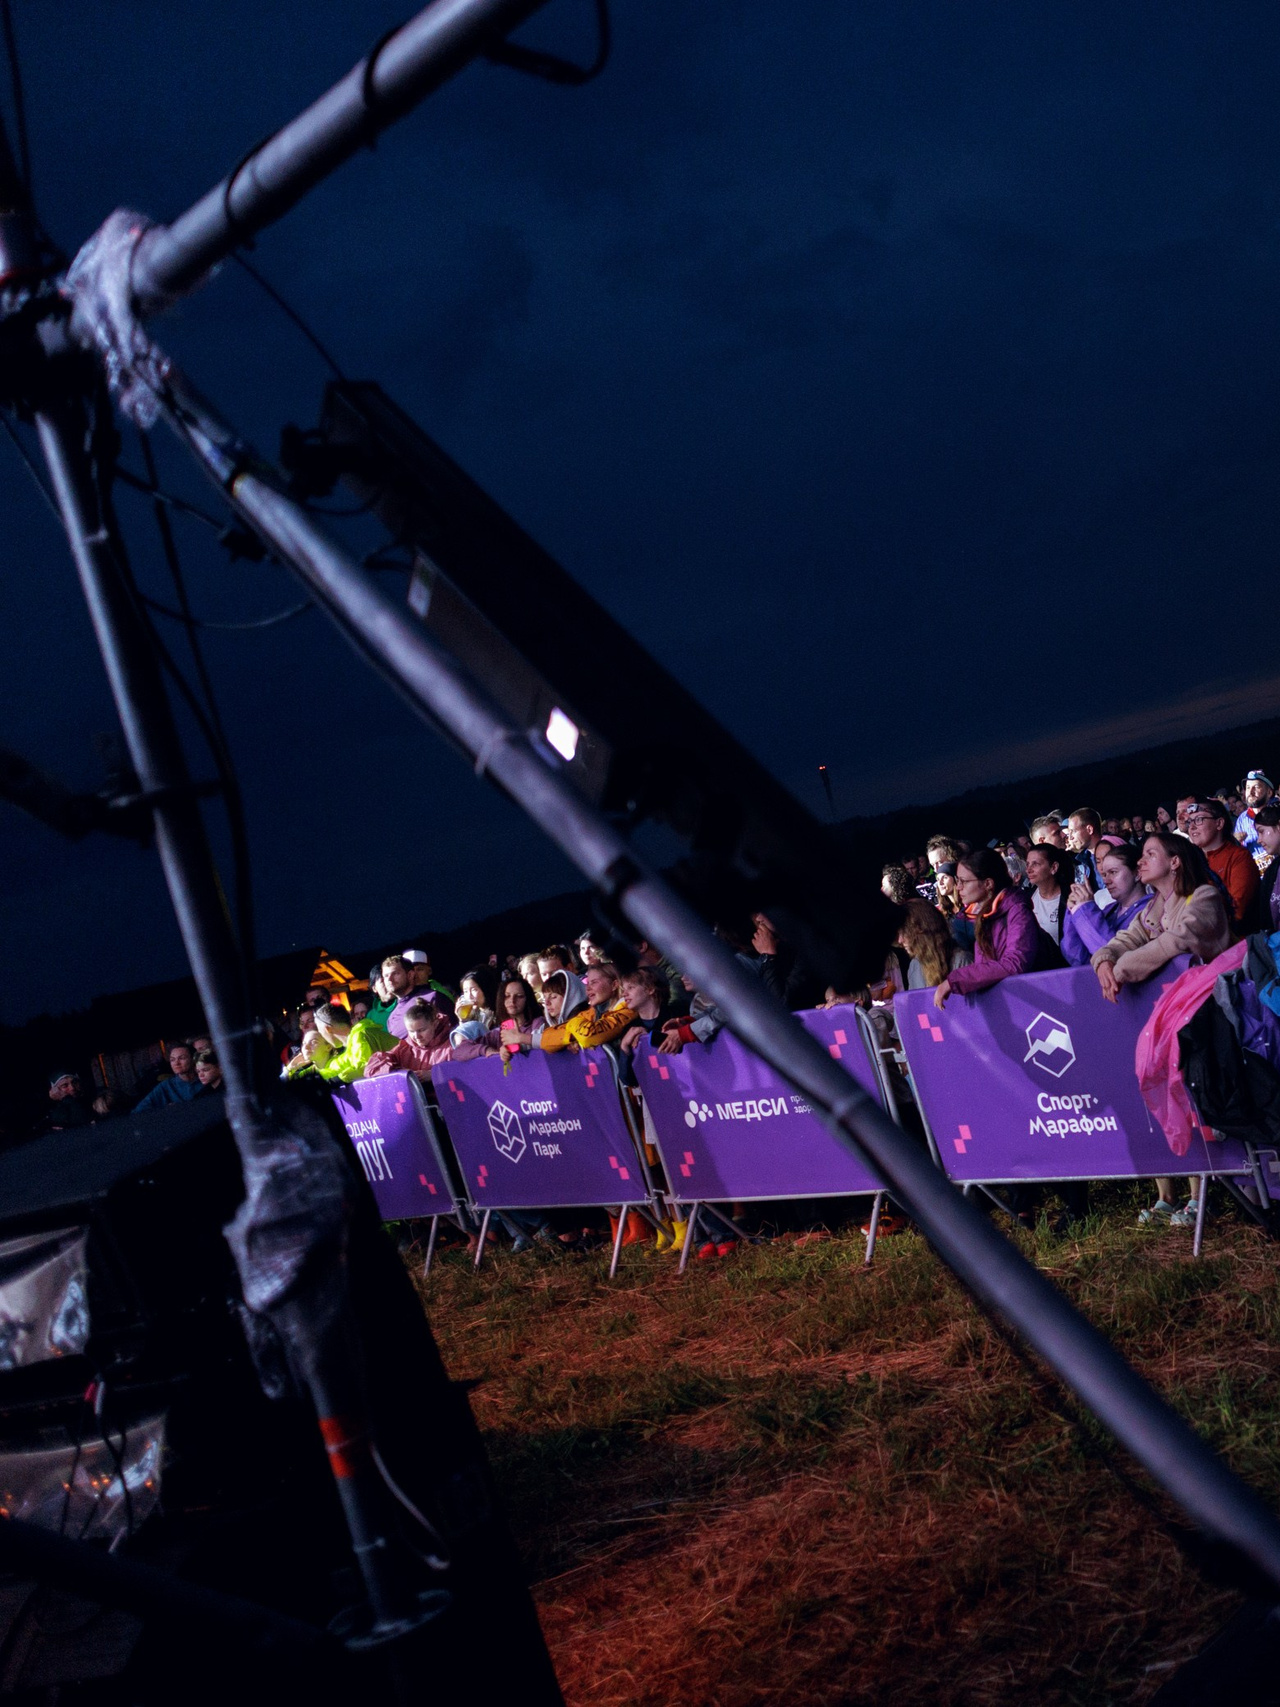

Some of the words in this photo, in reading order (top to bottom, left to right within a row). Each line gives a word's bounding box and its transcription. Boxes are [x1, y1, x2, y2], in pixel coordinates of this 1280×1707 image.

[715, 1097, 789, 1122] МЕДСИ
[794, 1105, 815, 1114] здор
[345, 1119, 381, 1138] ОДАЧА
[529, 1119, 582, 1137] Марафон
[1029, 1114, 1118, 1139] Марафон
[357, 1138, 393, 1182] ЛУГ
[532, 1142, 562, 1159] Парк
